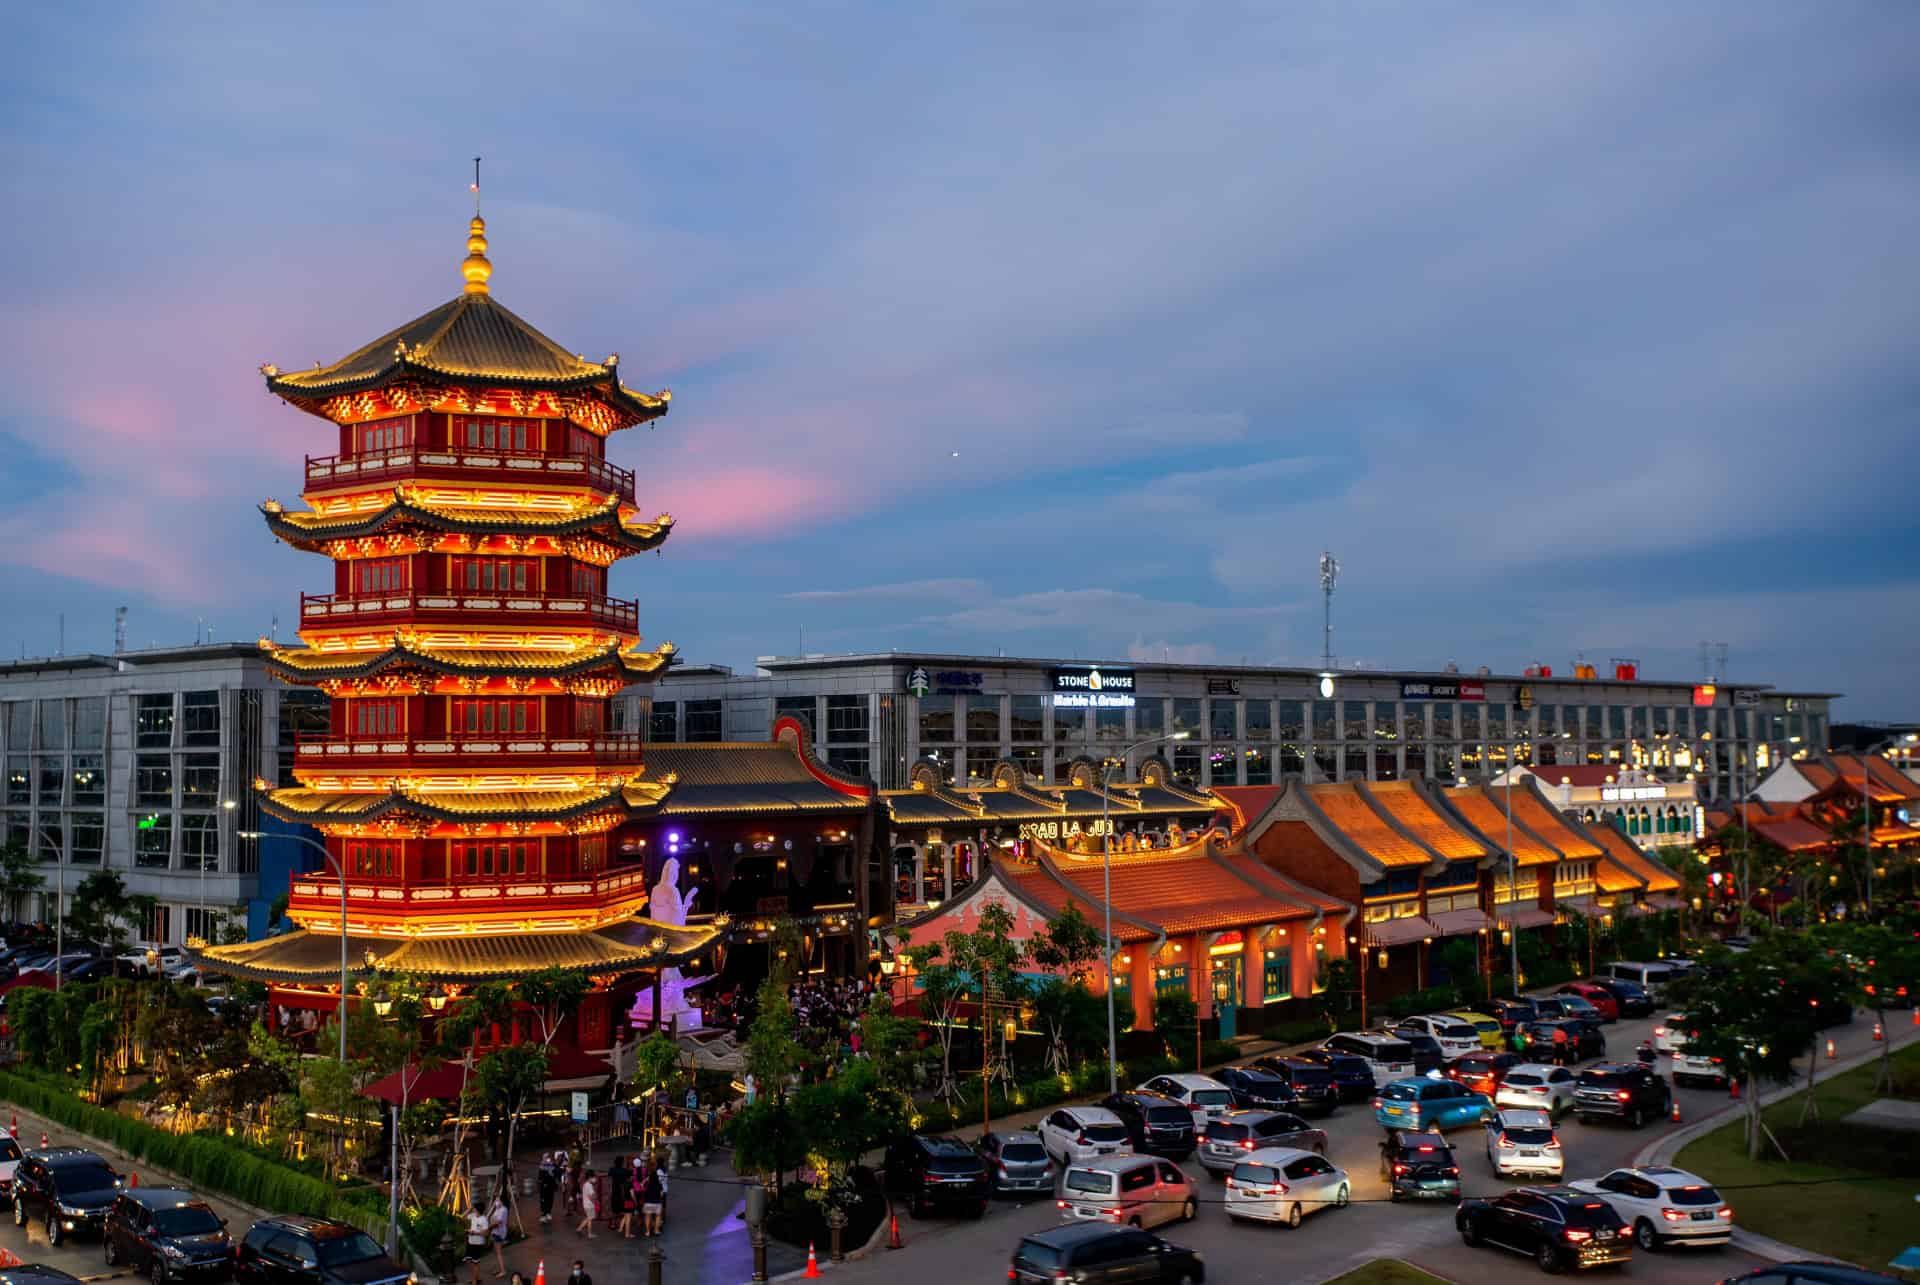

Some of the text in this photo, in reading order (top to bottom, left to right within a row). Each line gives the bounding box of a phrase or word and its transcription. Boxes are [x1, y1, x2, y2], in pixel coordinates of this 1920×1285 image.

[1058, 676, 1133, 688] STONE HOUSE
[1054, 693, 1088, 707] Marble
[1089, 695, 1097, 706] &
[1062, 820, 1081, 838] LA
